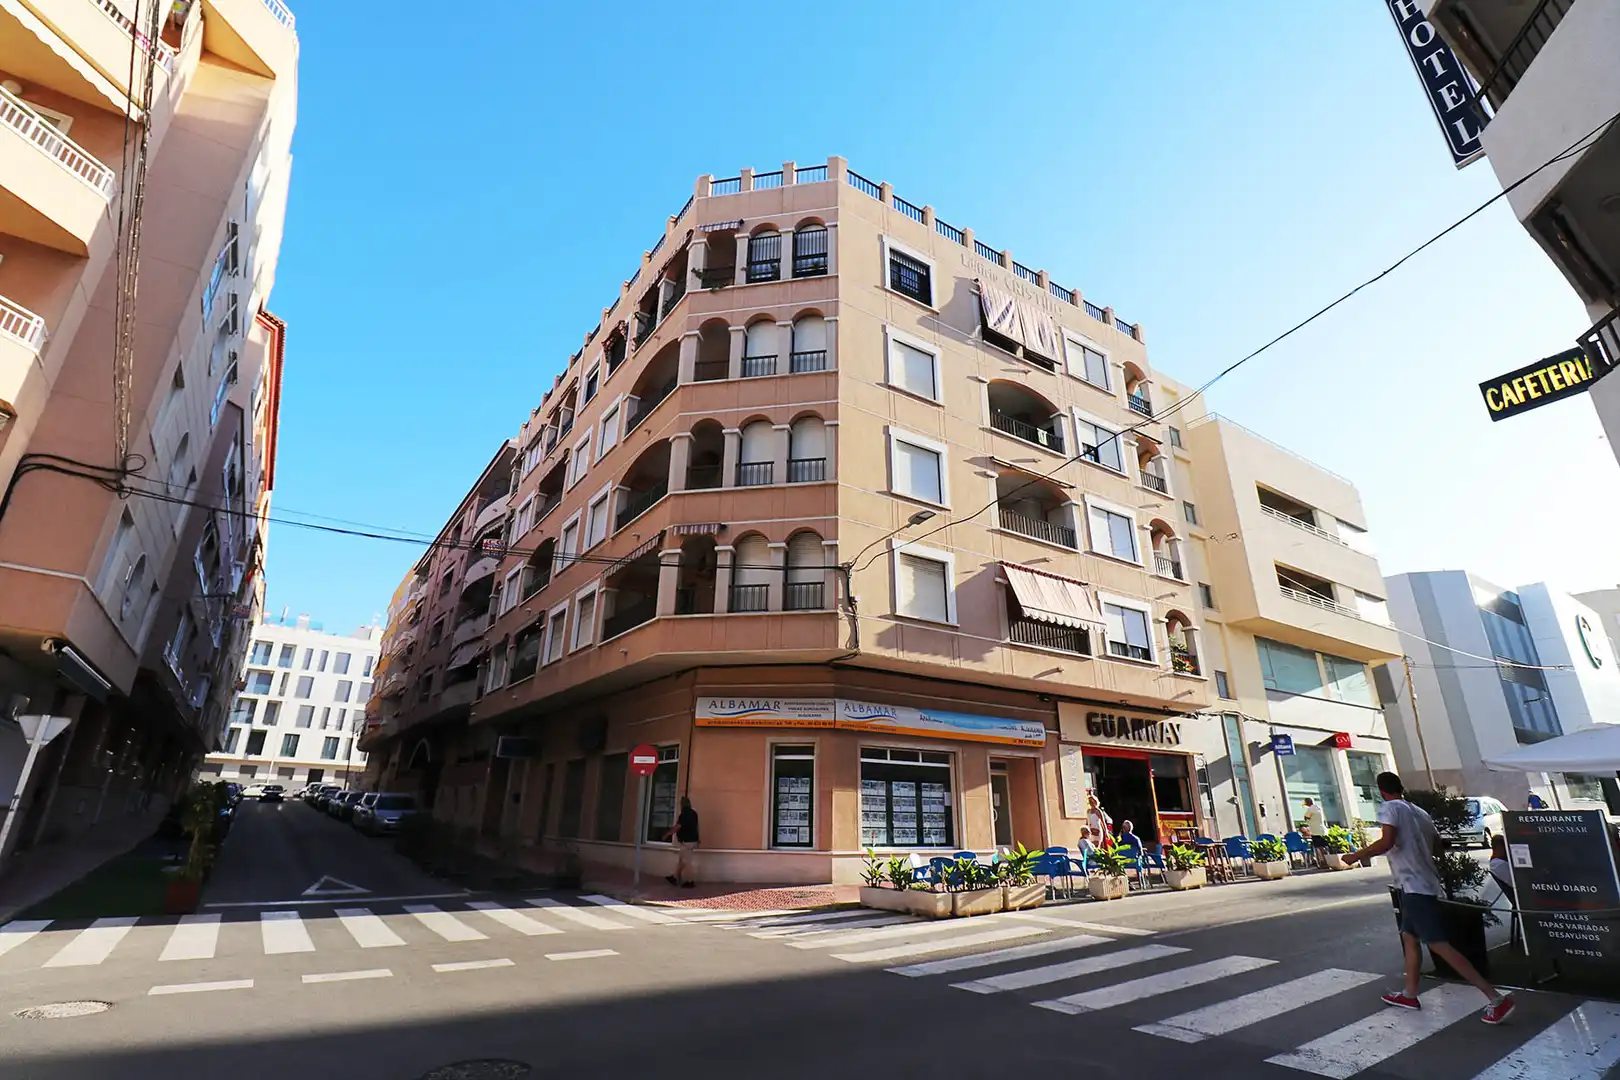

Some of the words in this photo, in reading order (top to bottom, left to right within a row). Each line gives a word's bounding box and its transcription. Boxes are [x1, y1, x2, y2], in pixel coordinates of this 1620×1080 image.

[1395, 0, 1481, 147] HOTEL
[708, 700, 781, 710] ALBAMAR
[843, 702, 897, 716] ALBAMAR
[1518, 815, 1583, 823] RESTAURANTE
[1538, 825, 1565, 833] EDEN
[1531, 882, 1560, 891] MENÚ
[1563, 885, 1598, 893] DIARIO
[1553, 912, 1590, 921] PAELLAS
[1538, 920, 1564, 929] TAPAS
[1566, 923, 1610, 933] VARIADAS
[1548, 930, 1601, 941] DESAYUNOS
